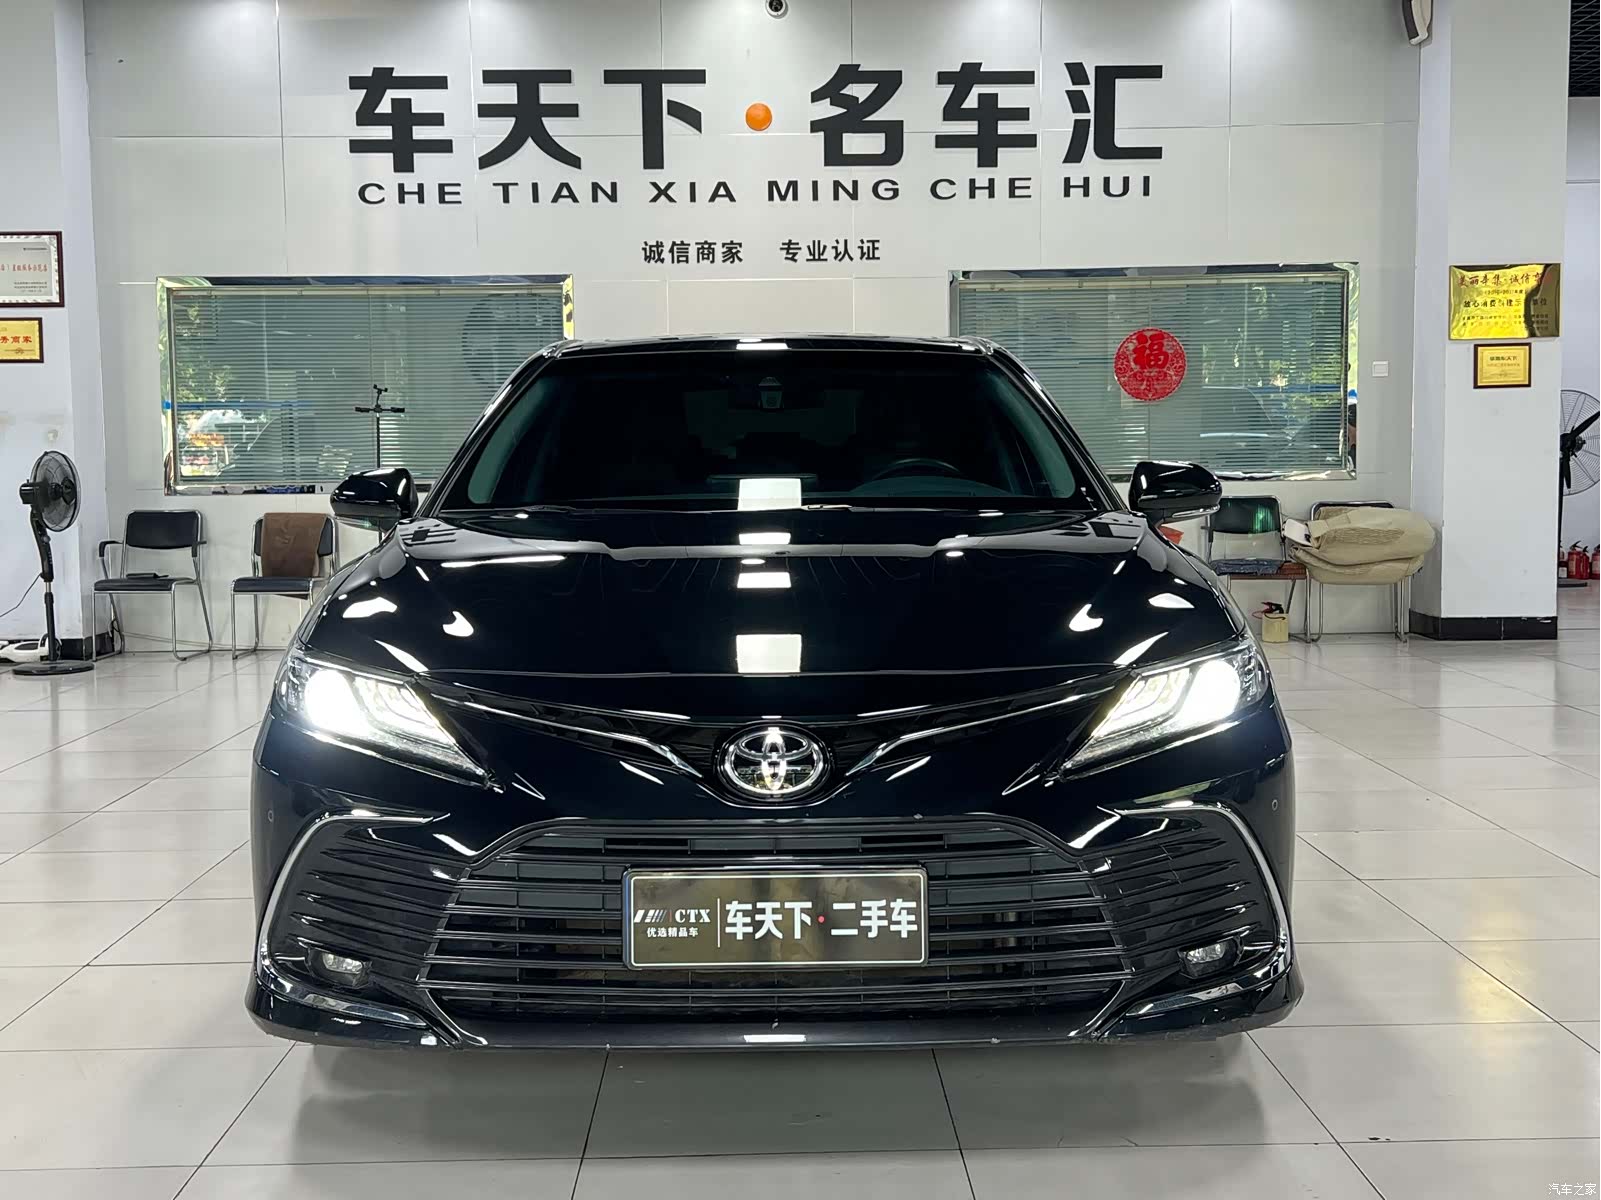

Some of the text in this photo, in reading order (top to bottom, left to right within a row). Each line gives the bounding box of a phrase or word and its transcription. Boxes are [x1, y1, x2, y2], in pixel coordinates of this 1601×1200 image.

[358, 175, 1150, 204] CHE TIAN XIA MING CHE HUI
[642, 238, 881, 264] 诚信商家 专业认证
[1132, 332, 1170, 370] 福
[674, 908, 711, 924] CTX
[646, 926, 699, 938] 优选精品车
